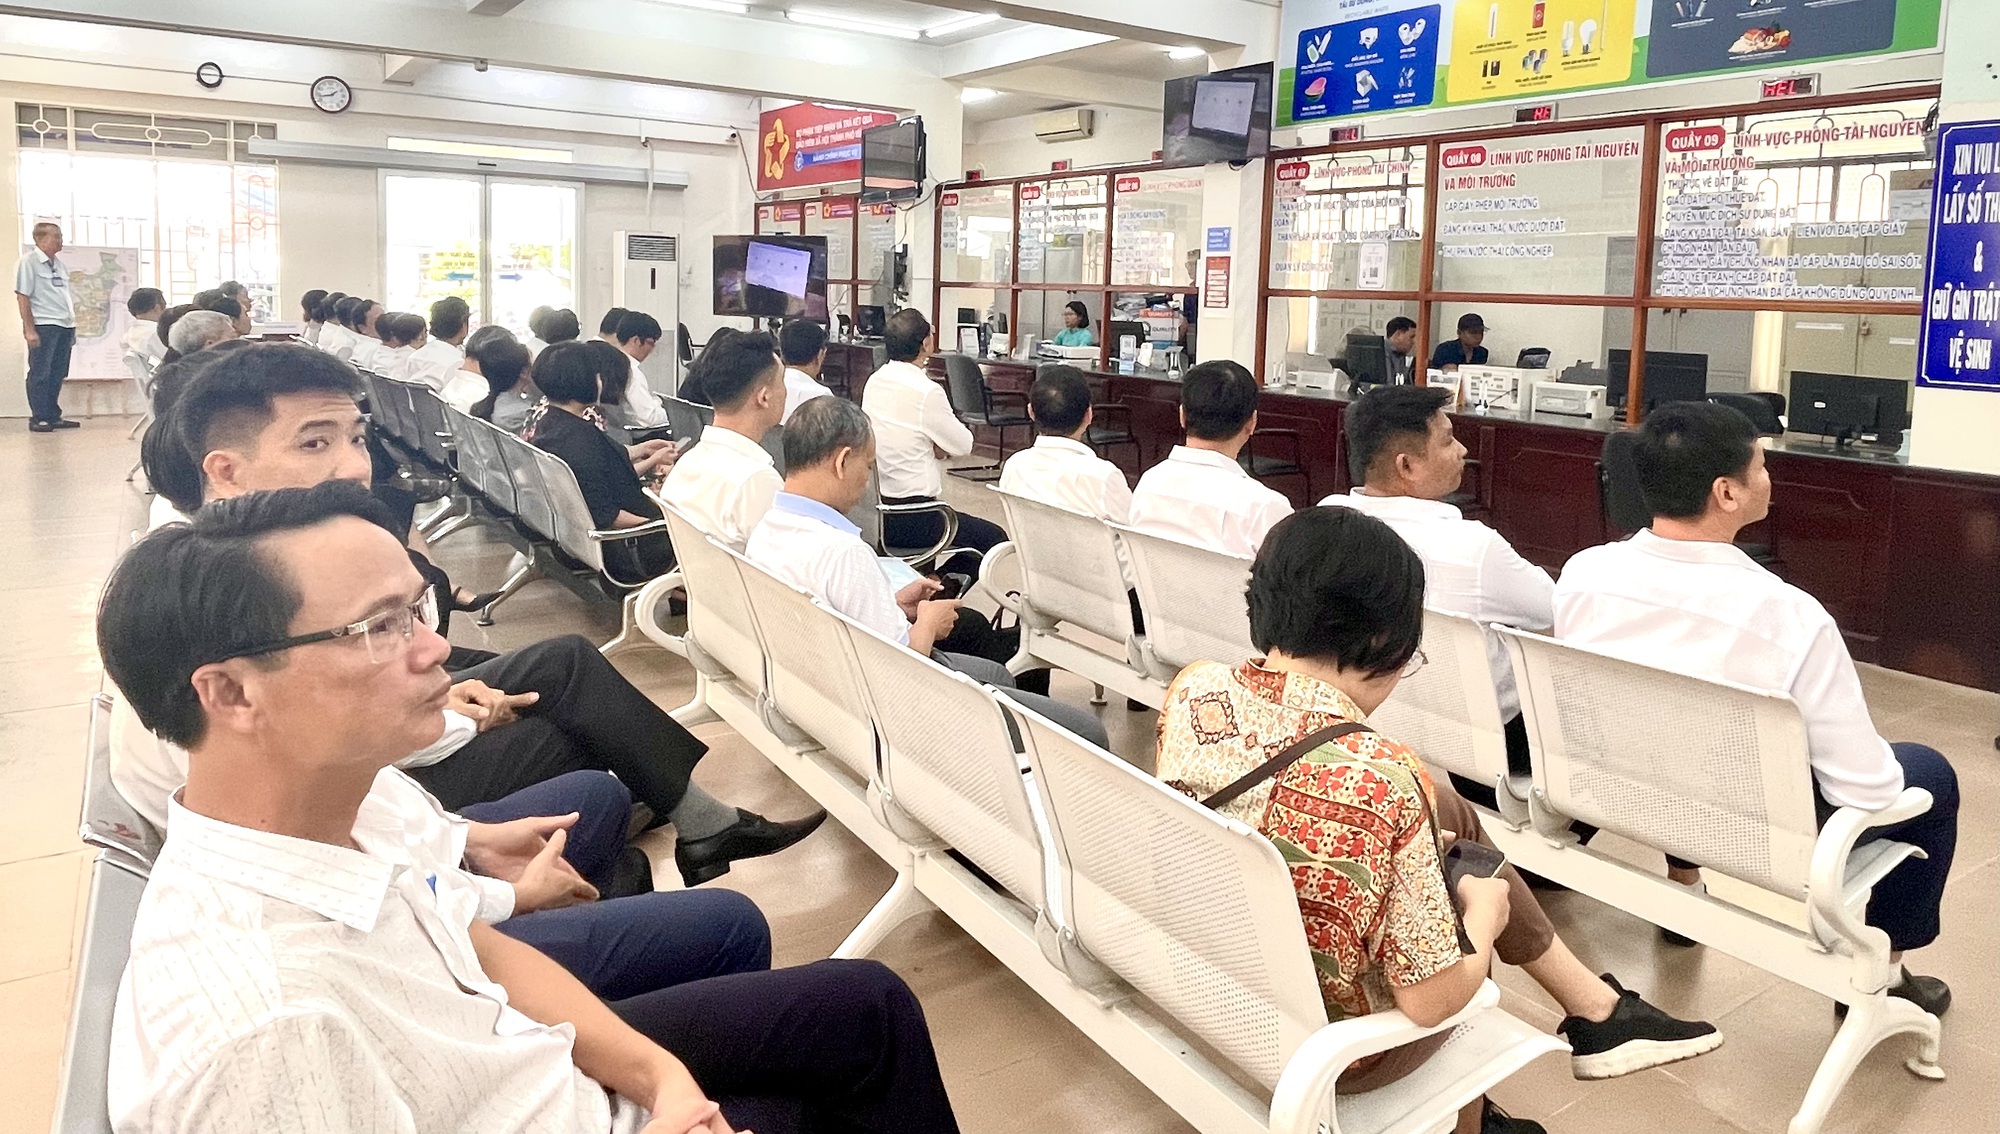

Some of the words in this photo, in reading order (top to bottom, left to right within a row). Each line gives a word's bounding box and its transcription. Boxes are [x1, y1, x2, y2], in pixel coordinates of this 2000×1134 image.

[1704, 134, 1719, 147] 09
[1844, 121, 1864, 140] TÀI
[1952, 143, 1973, 175] XIN
[1973, 142, 1993, 175] VUI
[1943, 180, 1966, 224] LẤY
[1966, 179, 1986, 224] SỐ
[1881, 256, 1897, 267] SAI
[1973, 240, 1983, 273] &
[1932, 281, 1953, 321] GIỮ
[1952, 281, 1971, 321] GÌN
[1972, 281, 2000, 328] TRẬT
[1949, 329, 1964, 375] VỆ
[1965, 338, 1993, 370] SINH
